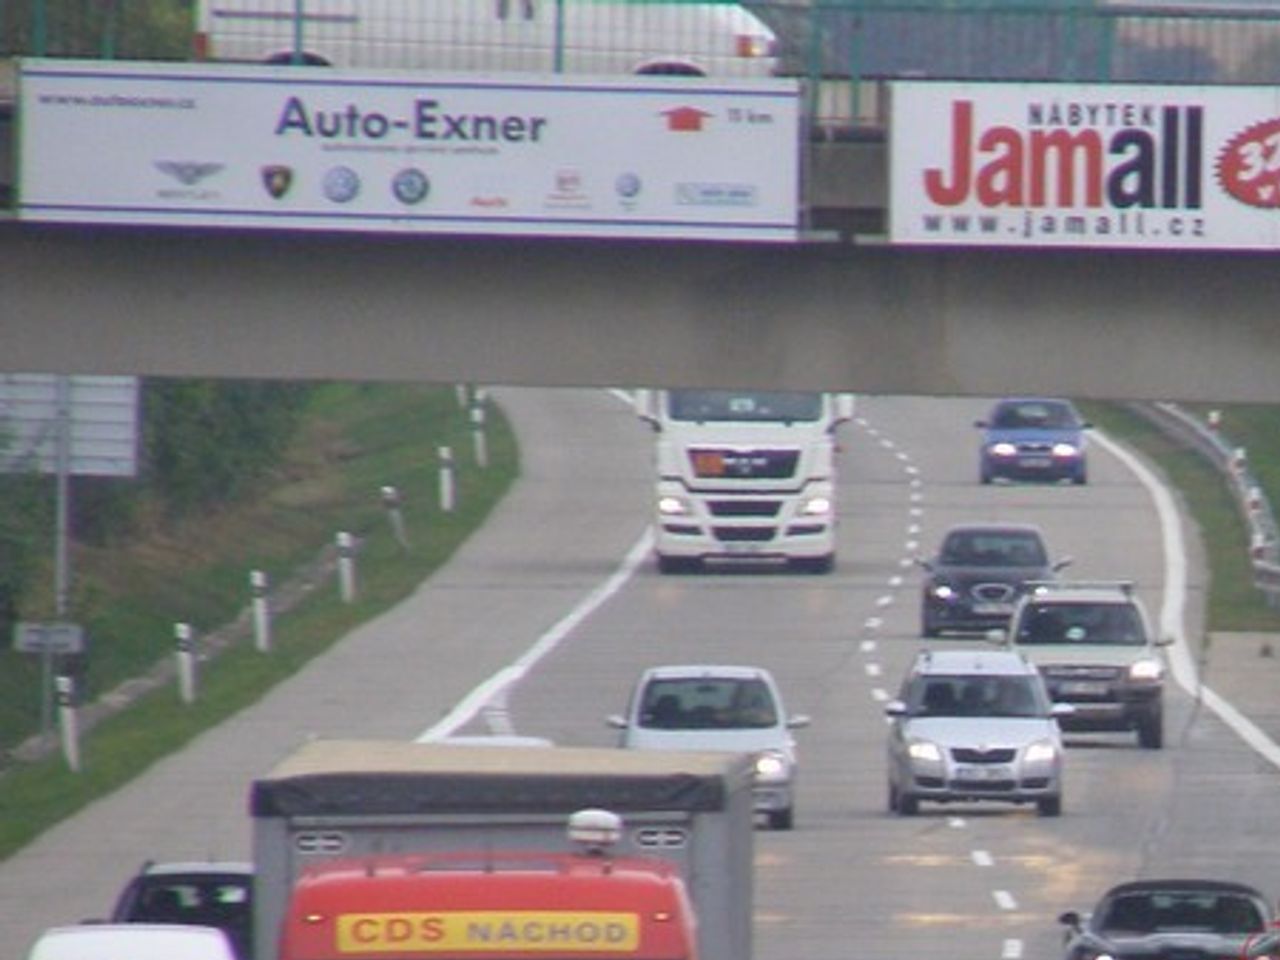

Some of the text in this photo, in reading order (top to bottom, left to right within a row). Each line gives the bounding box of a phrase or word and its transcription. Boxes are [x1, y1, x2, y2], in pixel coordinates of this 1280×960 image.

[274, 96, 547, 143] Auto-Exner
[923, 100, 1204, 210] Jamall
[923, 213, 1205, 238] www.jamall.cz
[351, 918, 446, 944] CDS
